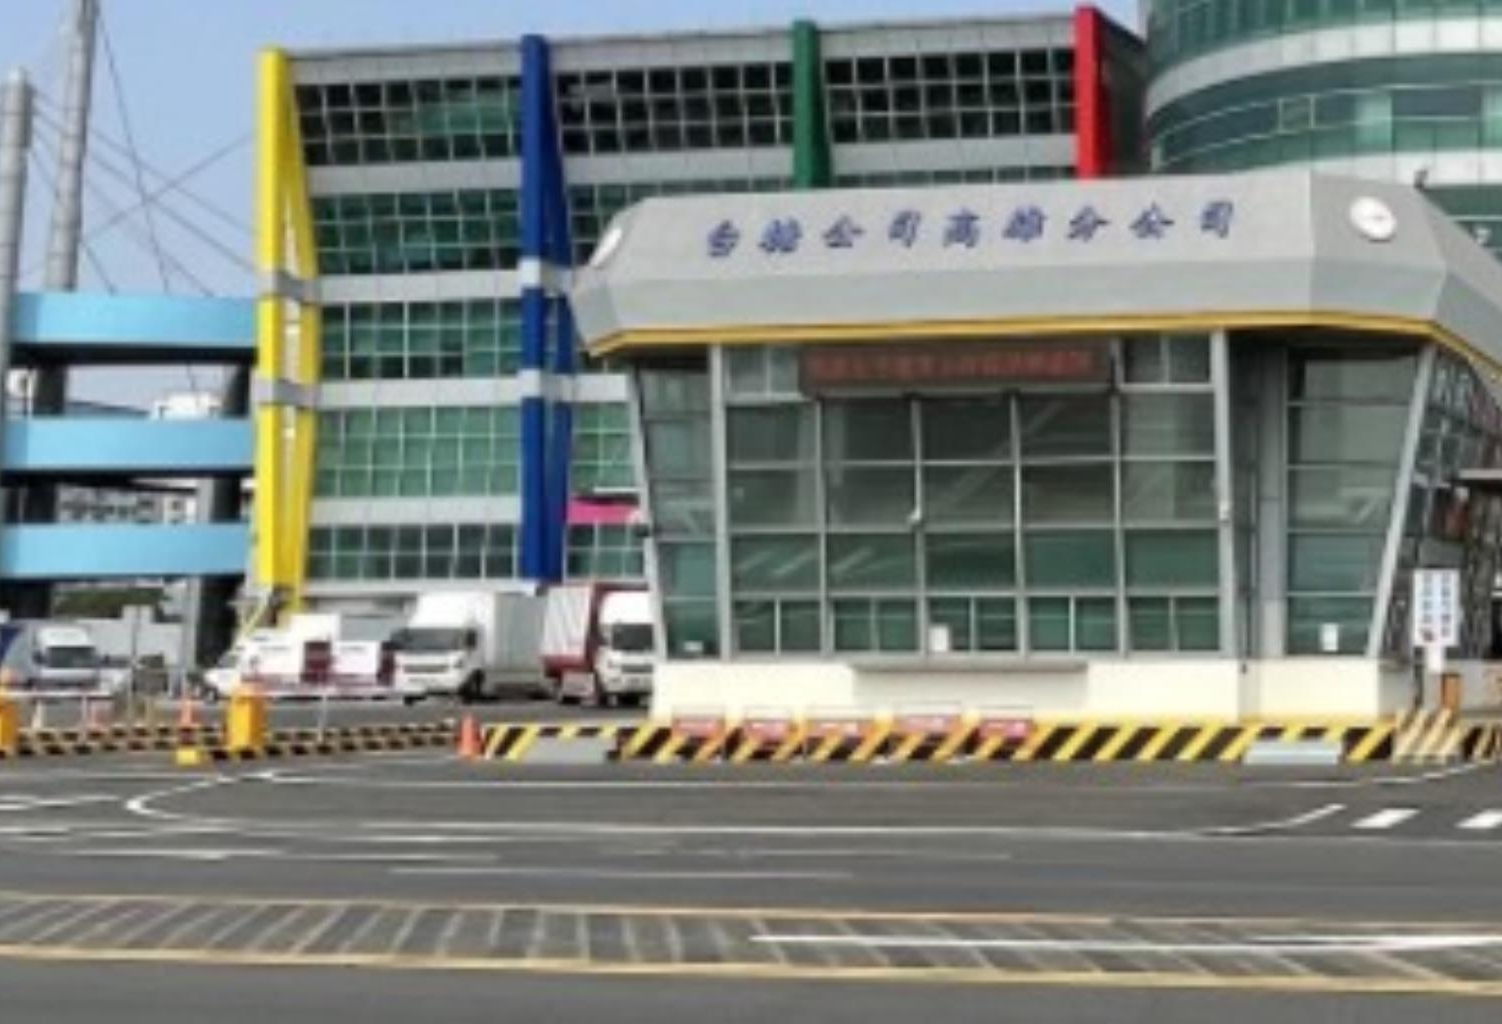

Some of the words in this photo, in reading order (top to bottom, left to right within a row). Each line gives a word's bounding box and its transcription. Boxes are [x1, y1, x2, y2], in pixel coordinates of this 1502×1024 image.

[707, 199, 1235, 259] 台糖公司高雄分公司
